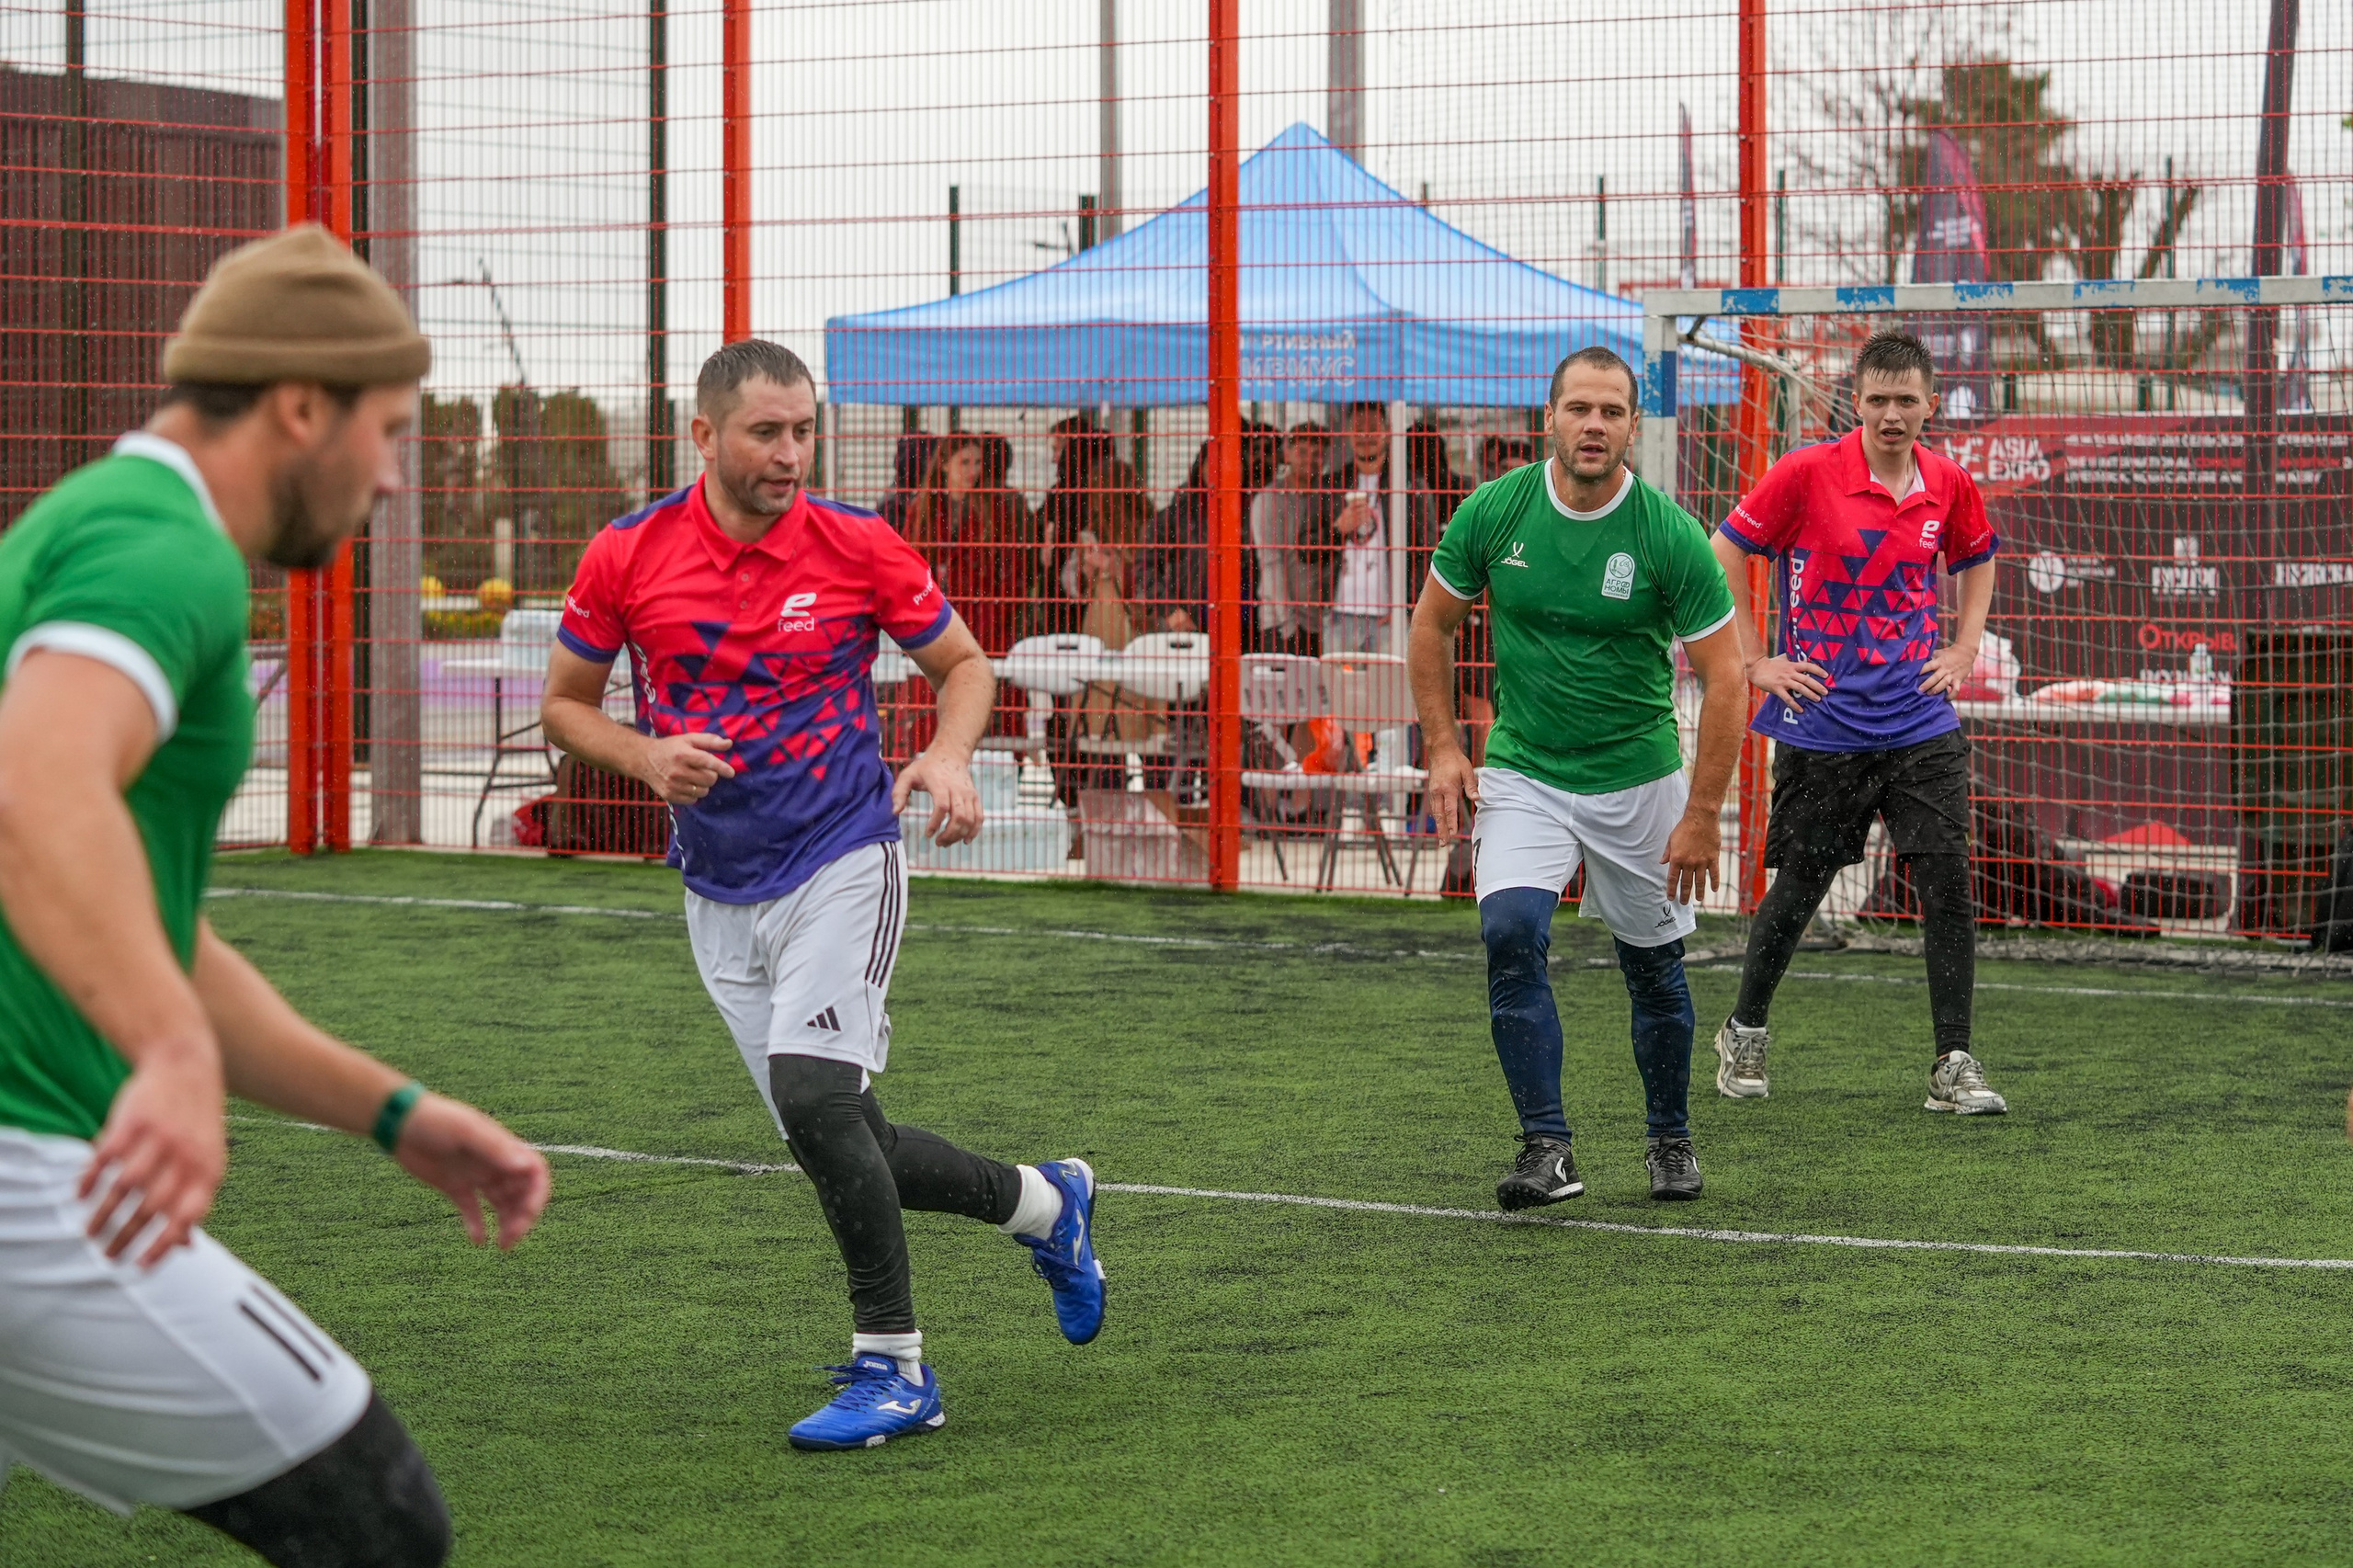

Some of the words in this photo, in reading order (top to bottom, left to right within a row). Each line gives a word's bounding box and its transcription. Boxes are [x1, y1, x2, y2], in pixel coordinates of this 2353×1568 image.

[1988, 437, 2043, 458] ASIA
[1988, 460, 2051, 482] EXPO
[1500, 557, 1529, 568] JÖGEL
[1604, 585, 1630, 595] НОМЫ
[778, 617, 815, 631] feed
